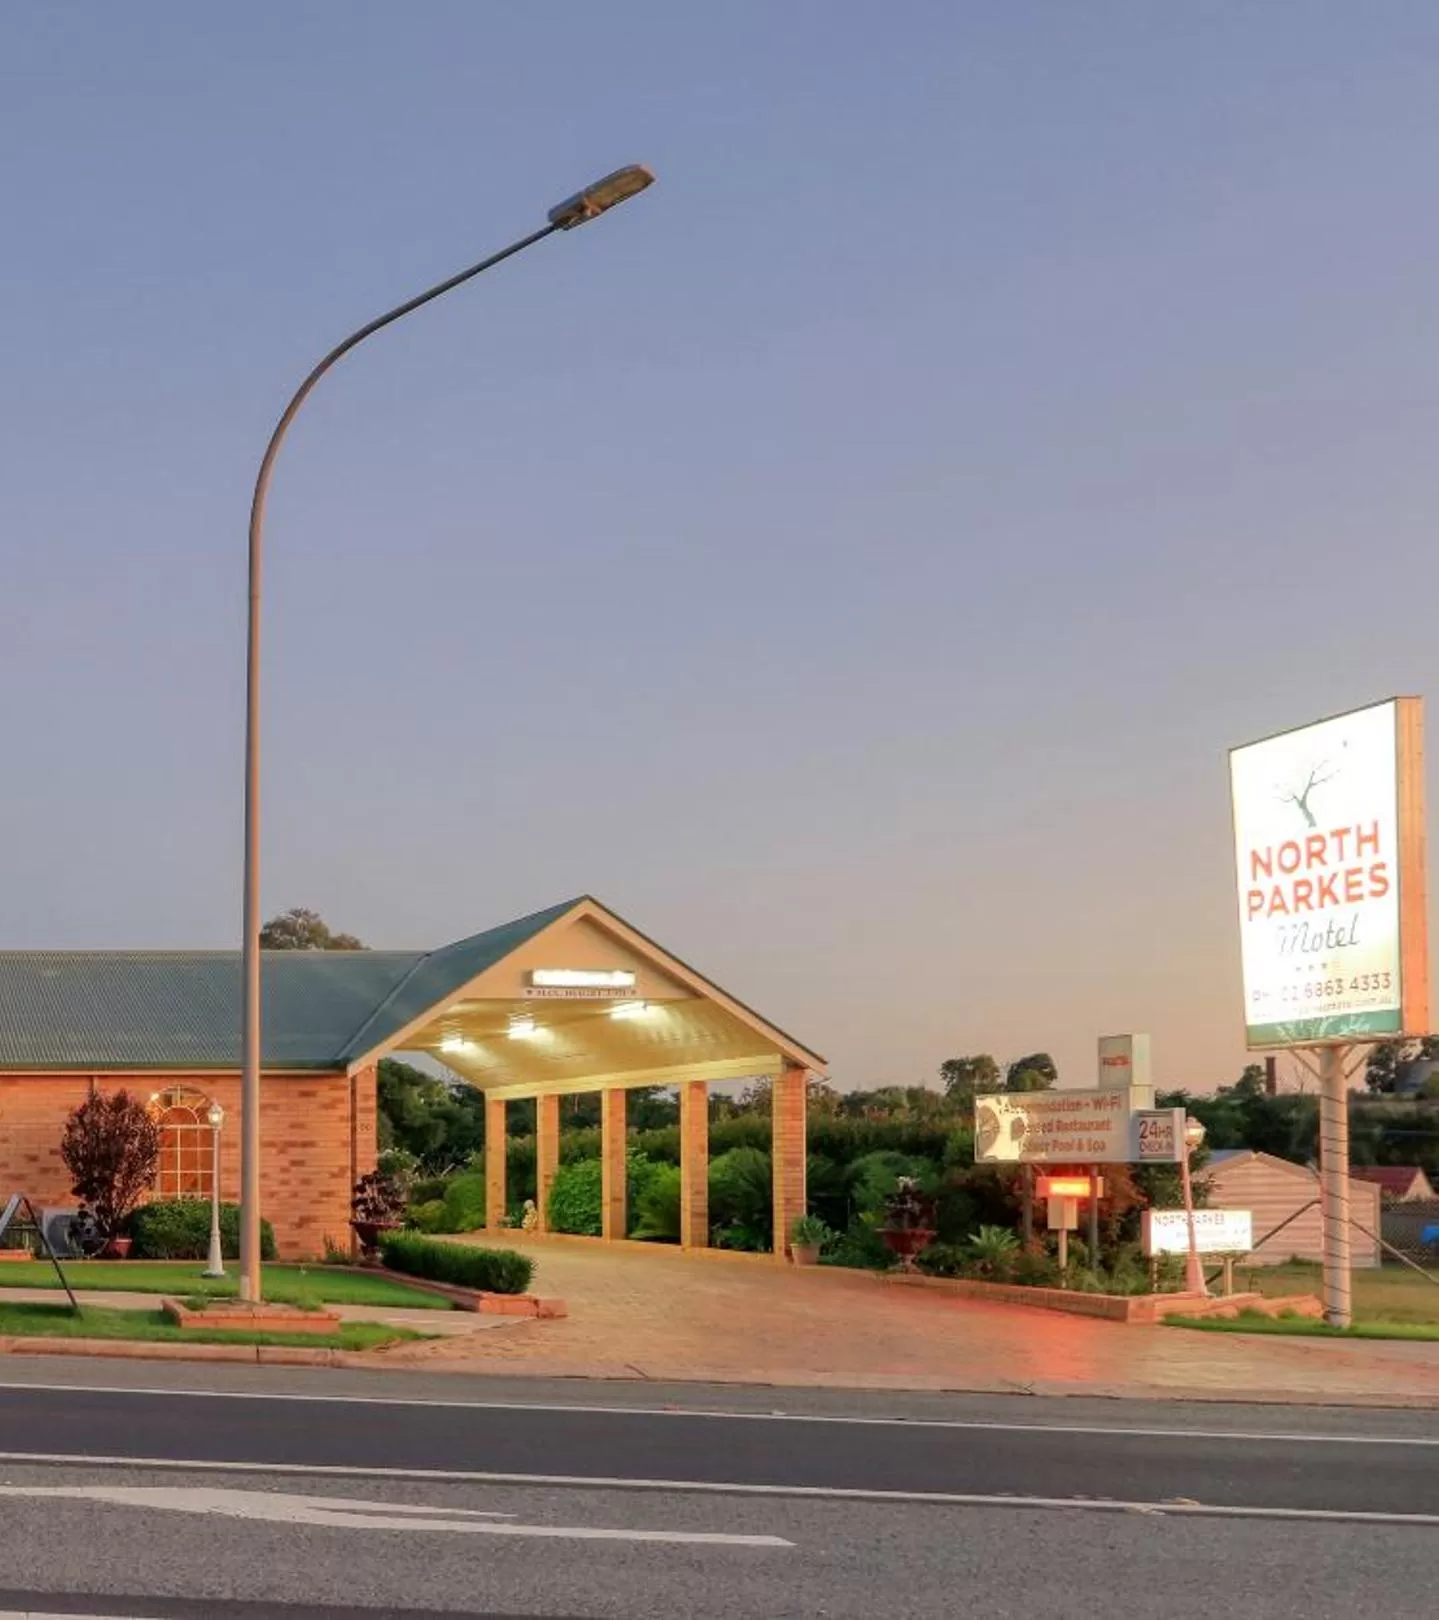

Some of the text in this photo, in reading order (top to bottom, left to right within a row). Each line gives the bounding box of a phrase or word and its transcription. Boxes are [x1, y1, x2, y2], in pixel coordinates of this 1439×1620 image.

[1250, 820, 1381, 881] NORTH
[1247, 862, 1391, 922] PARKES
[1276, 913, 1360, 957] Motel
[1304, 976, 1345, 999] 6863
[1349, 971, 1392, 994] 4333
